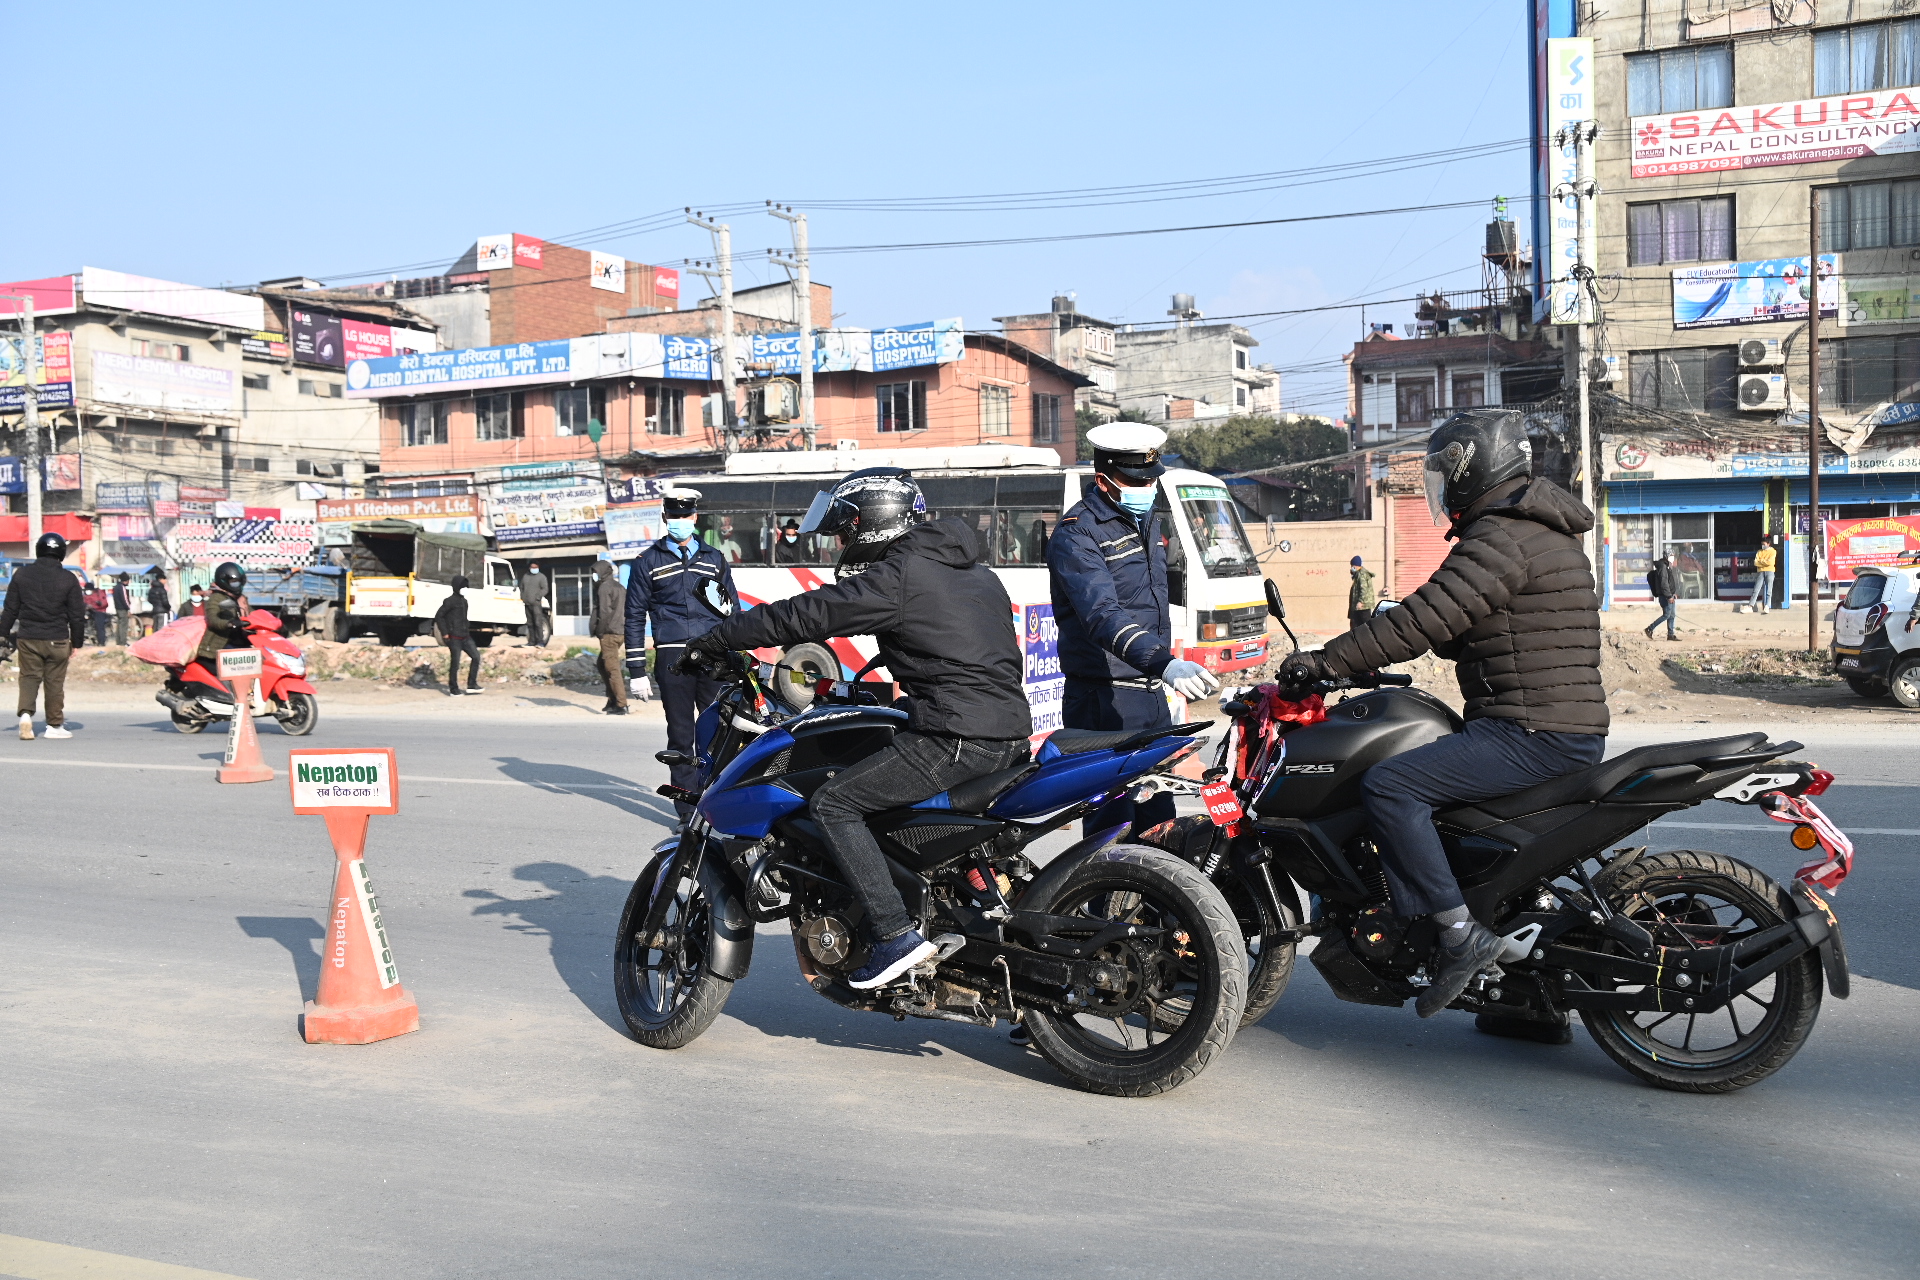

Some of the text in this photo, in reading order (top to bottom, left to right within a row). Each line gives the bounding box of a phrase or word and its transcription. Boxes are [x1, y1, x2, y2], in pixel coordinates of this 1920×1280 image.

[1669, 93, 1920, 139] SAKURA
[1670, 121, 1920, 156] NEPAL CONSULTANCY
[1752, 145, 1864, 164] www.sakuranepal.org
[1647, 158, 1740, 174] 014987092
[1700, 266, 1738, 277] Educational
[301, 314, 312, 323] LG
[345, 329, 391, 347] LG HOUSE
[667, 337, 709, 360] मेरो
[668, 358, 708, 372] MERO
[875, 344, 935, 364] HOSPITAL
[97, 351, 230, 383] MERO DENTAL HOSPITAL
[399, 355, 419, 369] मेरो
[370, 357, 570, 387] MERO DENTAL HOSPITAL PVT. LTD.
[319, 498, 473, 518] Best Kitchen Pvt. Ltd.
[273, 525, 313, 537] CYCLE
[279, 543, 310, 554] SHOP
[222, 655, 257, 665] Nepatop
[1032, 712, 1056, 733] RAFFIC
[297, 763, 378, 784] Nepatop
[333, 786, 351, 797] ठिक
[353, 788, 371, 797] ठाक
[332, 897, 350, 968] Nepatop
